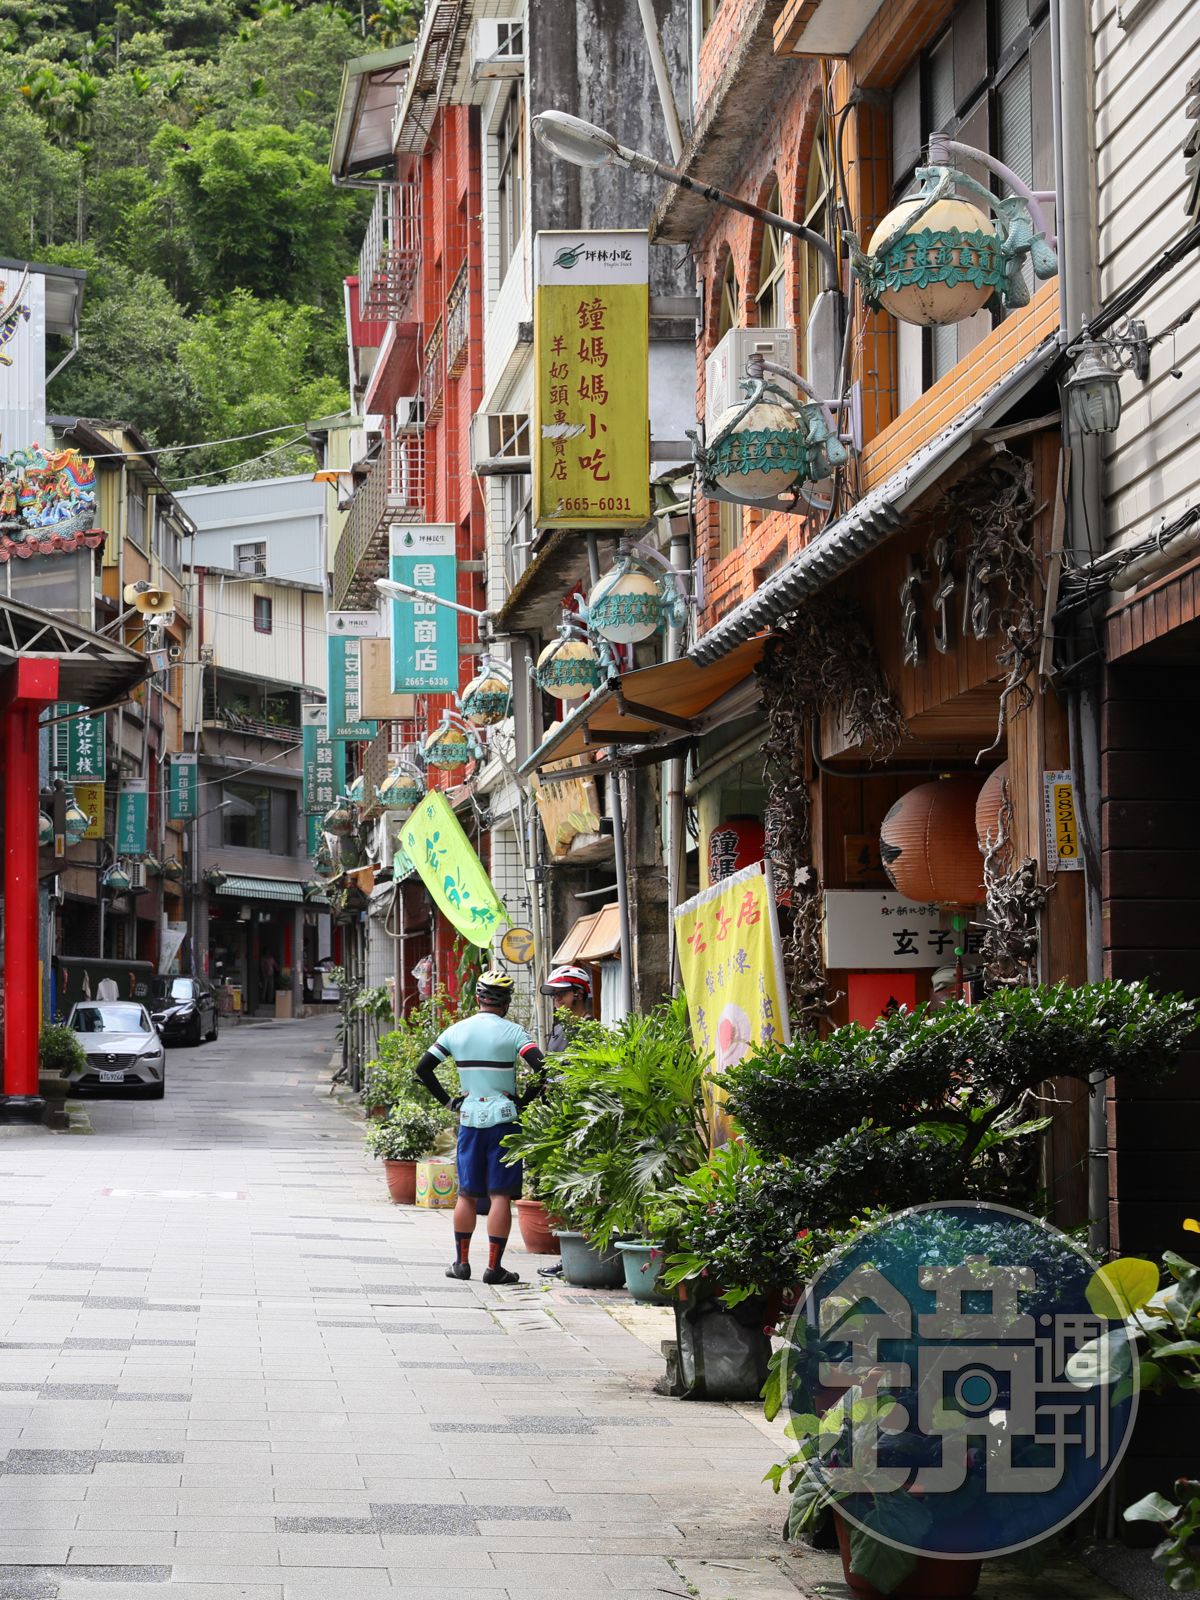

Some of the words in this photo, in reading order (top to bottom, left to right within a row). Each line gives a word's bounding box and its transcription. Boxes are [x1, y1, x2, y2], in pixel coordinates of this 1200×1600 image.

[585, 250, 632, 262] 坪林小吃
[576, 298, 610, 482] 鐘媽媽小吃
[405, 677, 448, 686] 2665-6336
[1058, 787, 1074, 856] 582140
